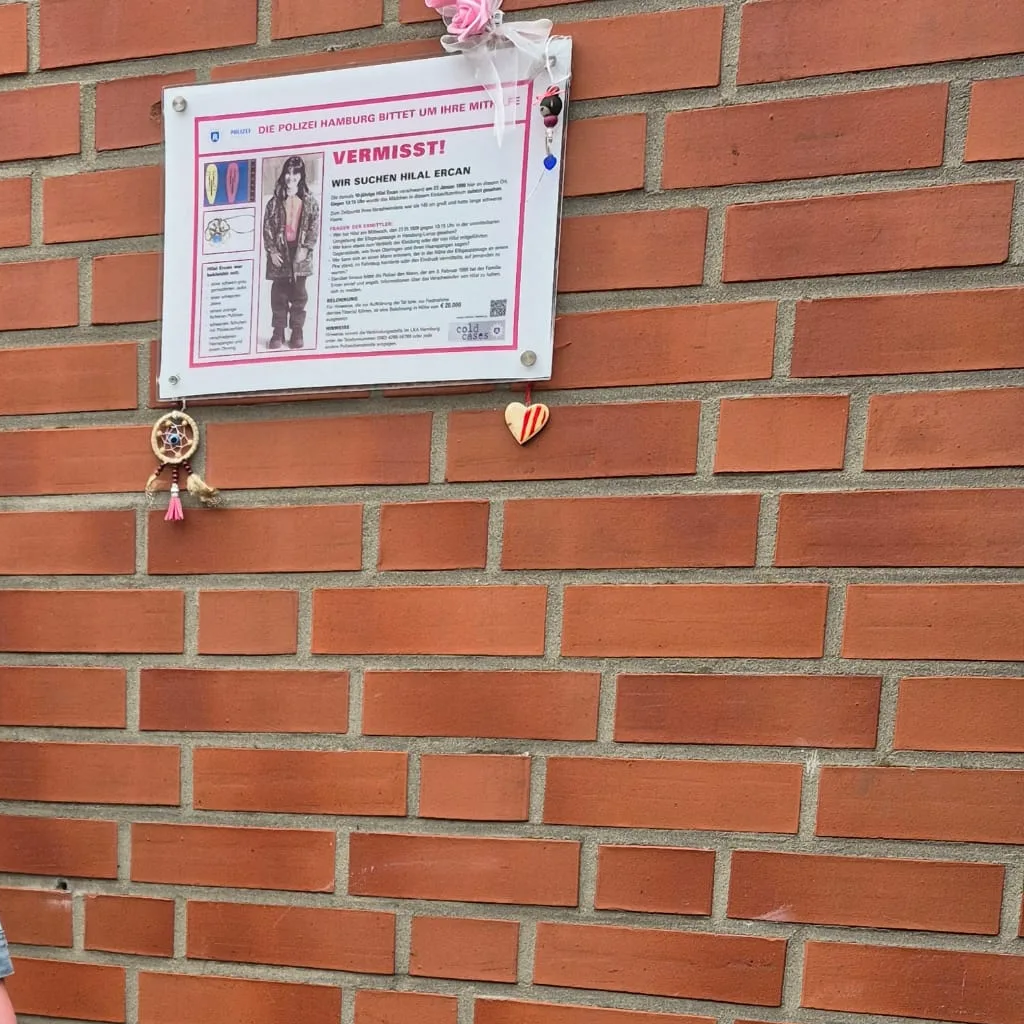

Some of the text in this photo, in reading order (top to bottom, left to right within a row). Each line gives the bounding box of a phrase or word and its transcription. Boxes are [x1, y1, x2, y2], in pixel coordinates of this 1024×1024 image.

[258, 124, 275, 135] DIE
[278, 121, 317, 132] POLIZEI
[321, 114, 375, 128] HAMBURG
[379, 109, 416, 122] BITTET
[419, 107, 437, 116] UM
[441, 103, 466, 114] IHRE
[333, 139, 446, 165] VERMISST!
[331, 166, 471, 188] WIR SUCHEN HILAL ERCAN
[456, 322, 478, 333] cold
[462, 331, 488, 340] cases
